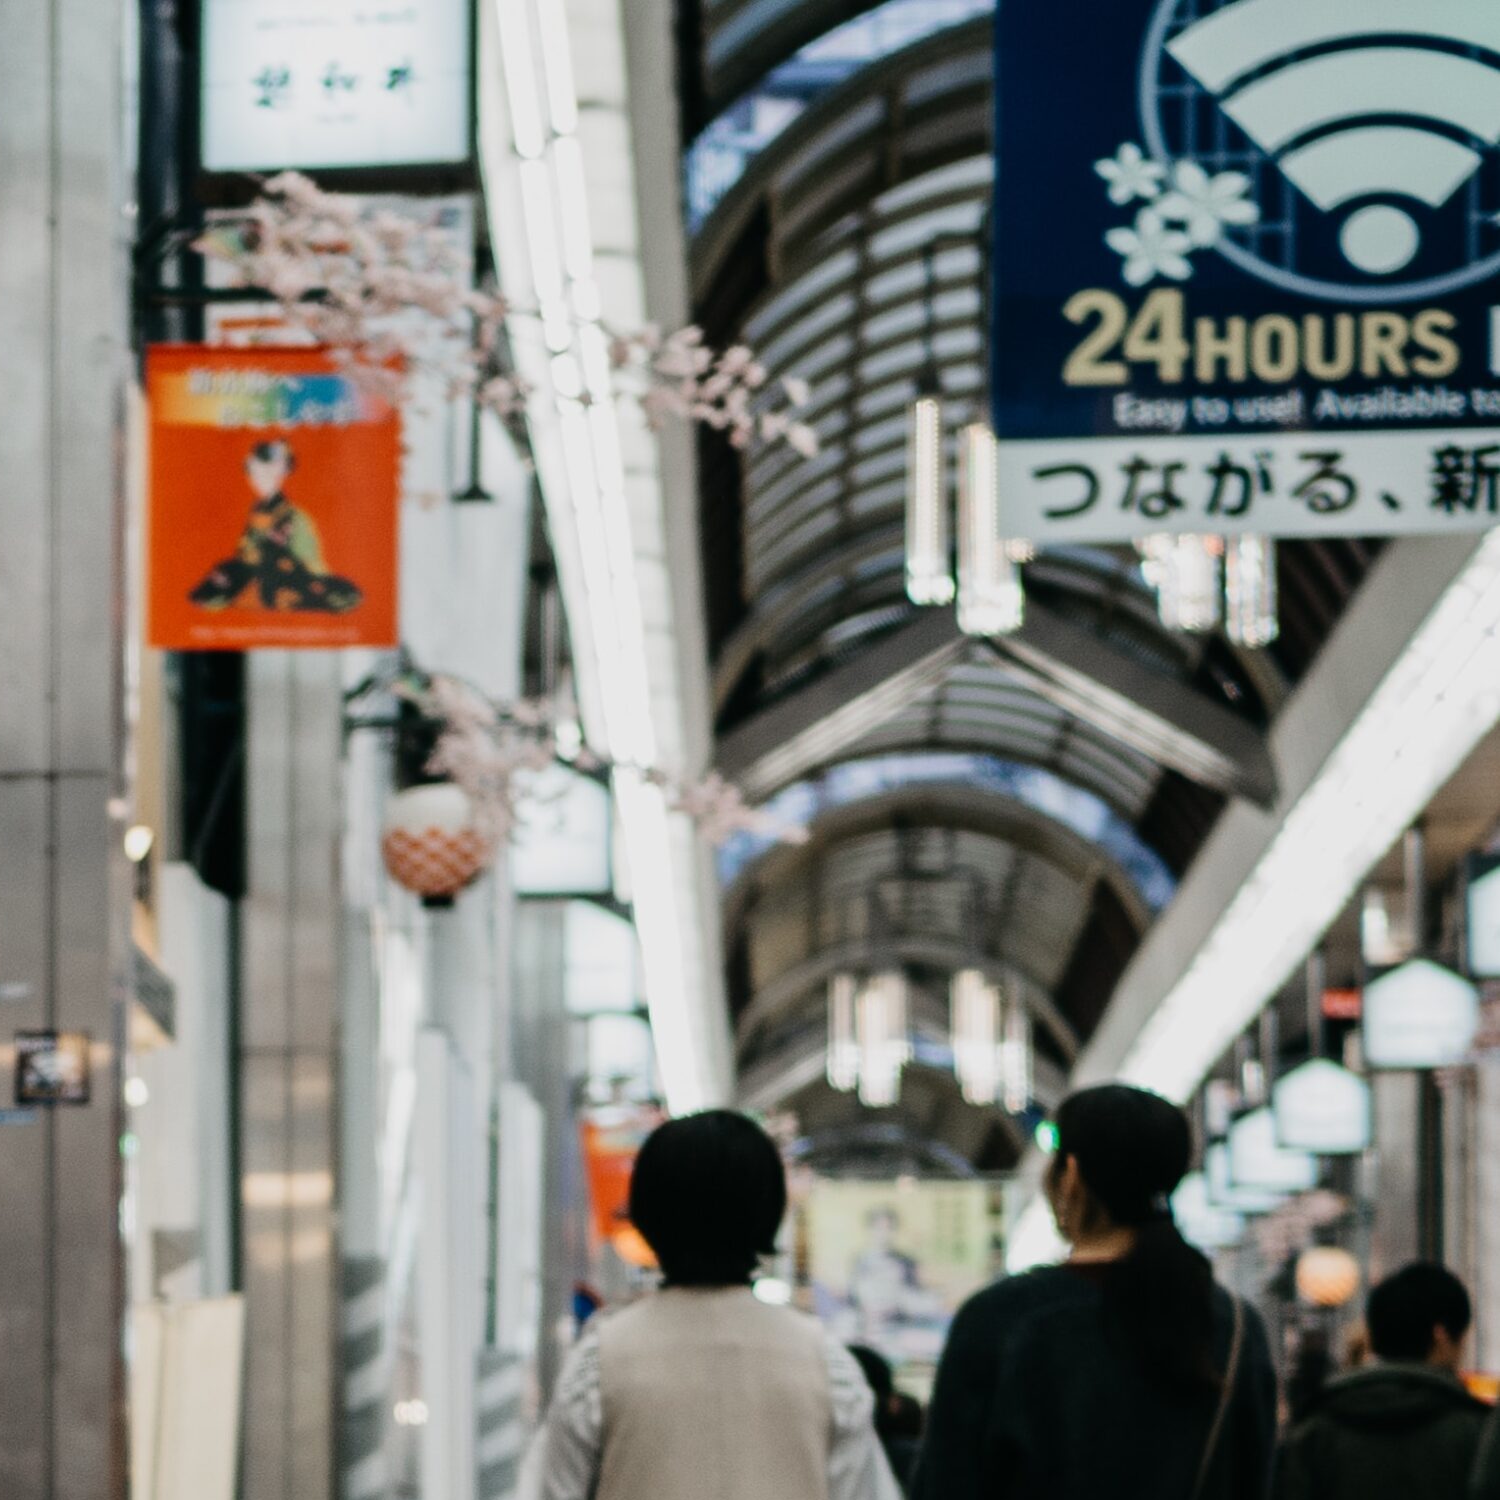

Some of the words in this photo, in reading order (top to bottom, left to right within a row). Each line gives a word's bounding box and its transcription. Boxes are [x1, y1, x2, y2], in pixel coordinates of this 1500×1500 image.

[1112, 391, 1187, 431] Easy
[1193, 395, 1229, 424] to
[1313, 384, 1466, 420] Available
